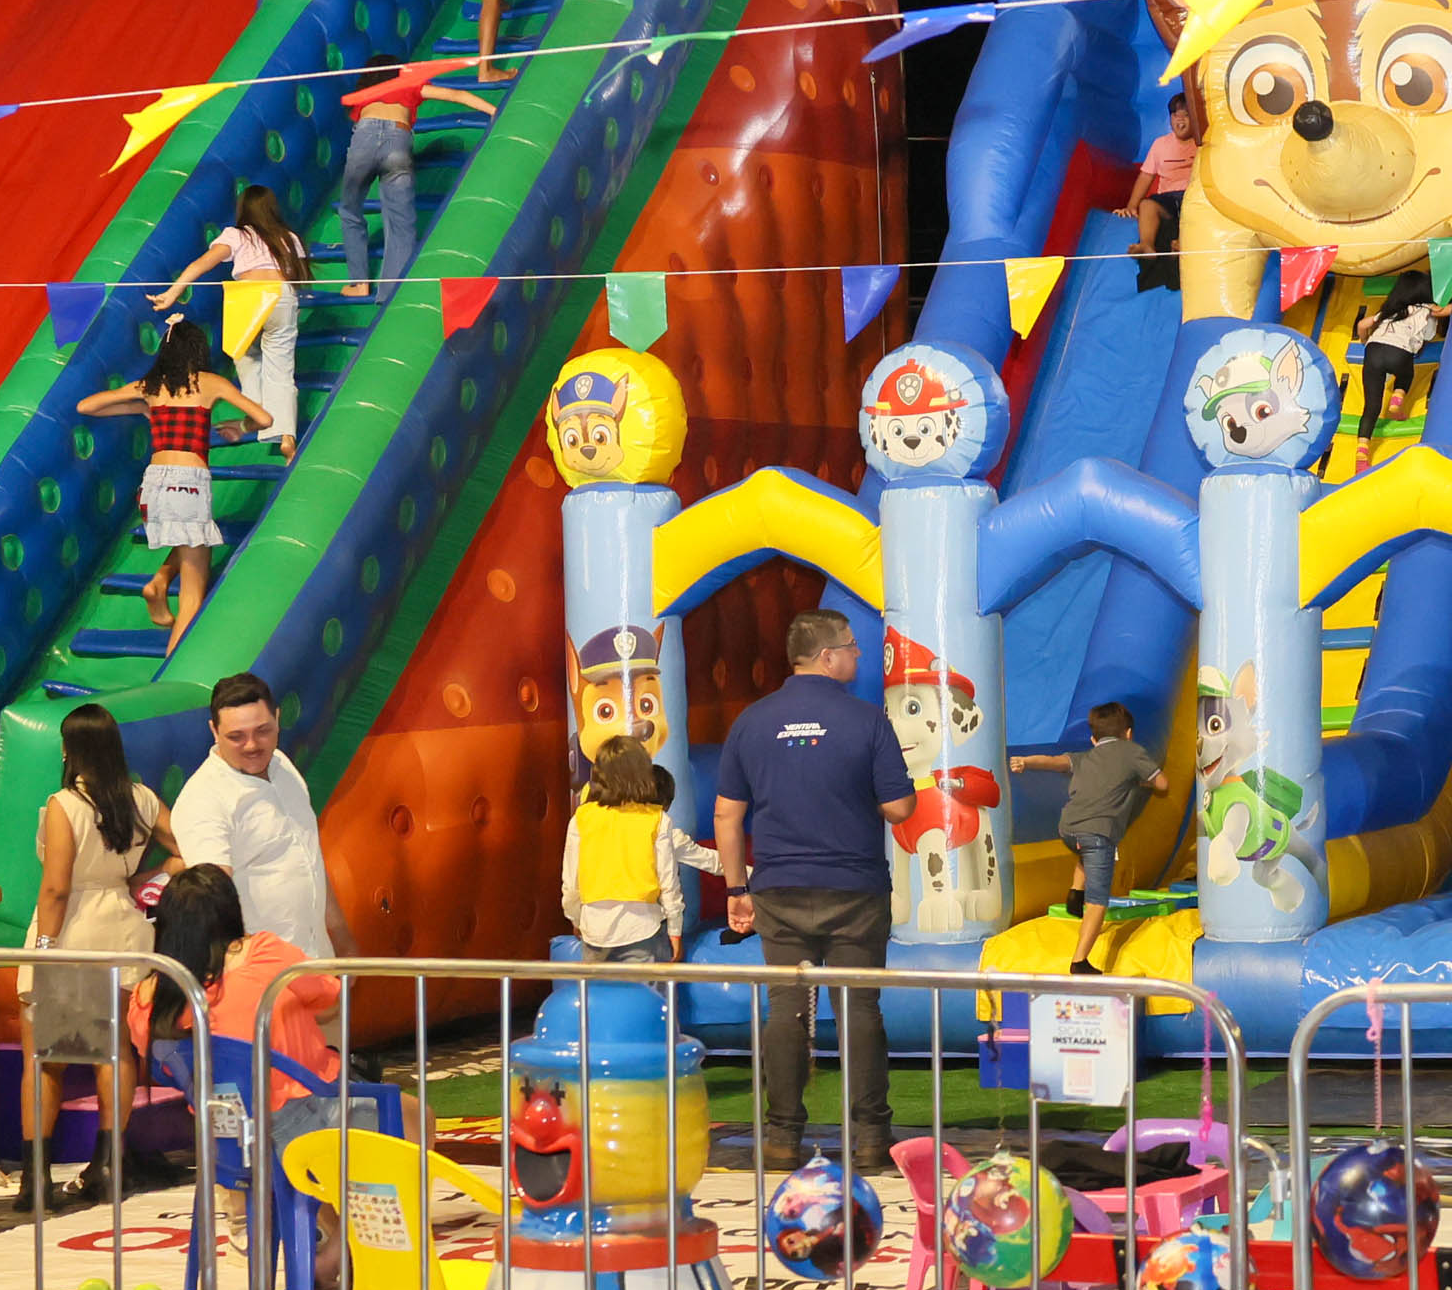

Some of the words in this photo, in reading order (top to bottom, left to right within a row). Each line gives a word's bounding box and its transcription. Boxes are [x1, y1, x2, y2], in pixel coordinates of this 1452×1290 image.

[1057, 1026, 1082, 1037] SIGA
[1085, 1027, 1102, 1037] NO
[1052, 1036, 1107, 1046] INSTAGRAM
